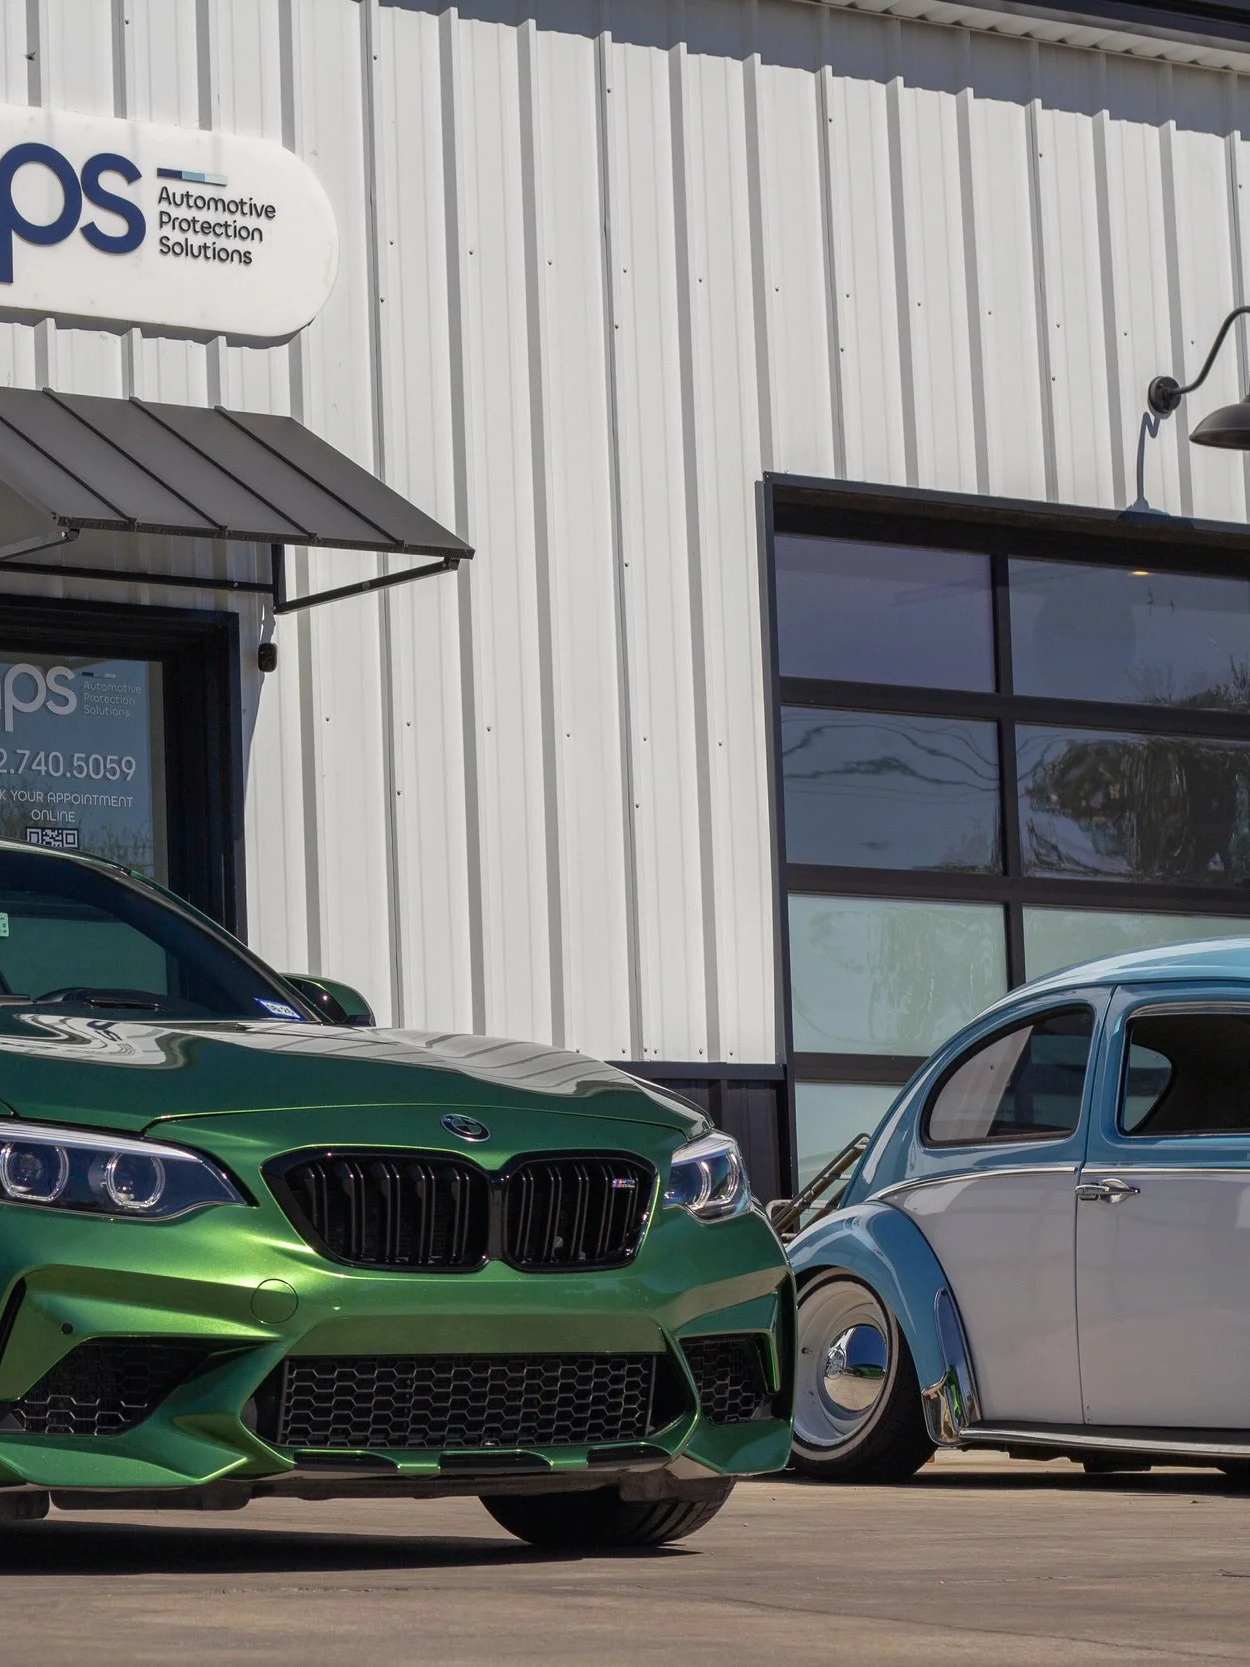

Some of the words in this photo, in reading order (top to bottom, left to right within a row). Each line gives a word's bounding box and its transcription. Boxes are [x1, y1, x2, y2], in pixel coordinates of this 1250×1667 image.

[158, 186, 276, 219] Automotive
[159, 210, 263, 243] Protection
[159, 236, 253, 265] Solutions
[83, 680, 142, 694] Automotive
[83, 693, 135, 705] Protection
[83, 704, 131, 717] Solutions
[10, 789, 44, 803] YOUR
[47, 791, 134, 808] APPOINTMENT
[31, 808, 76, 823] ONLINE
